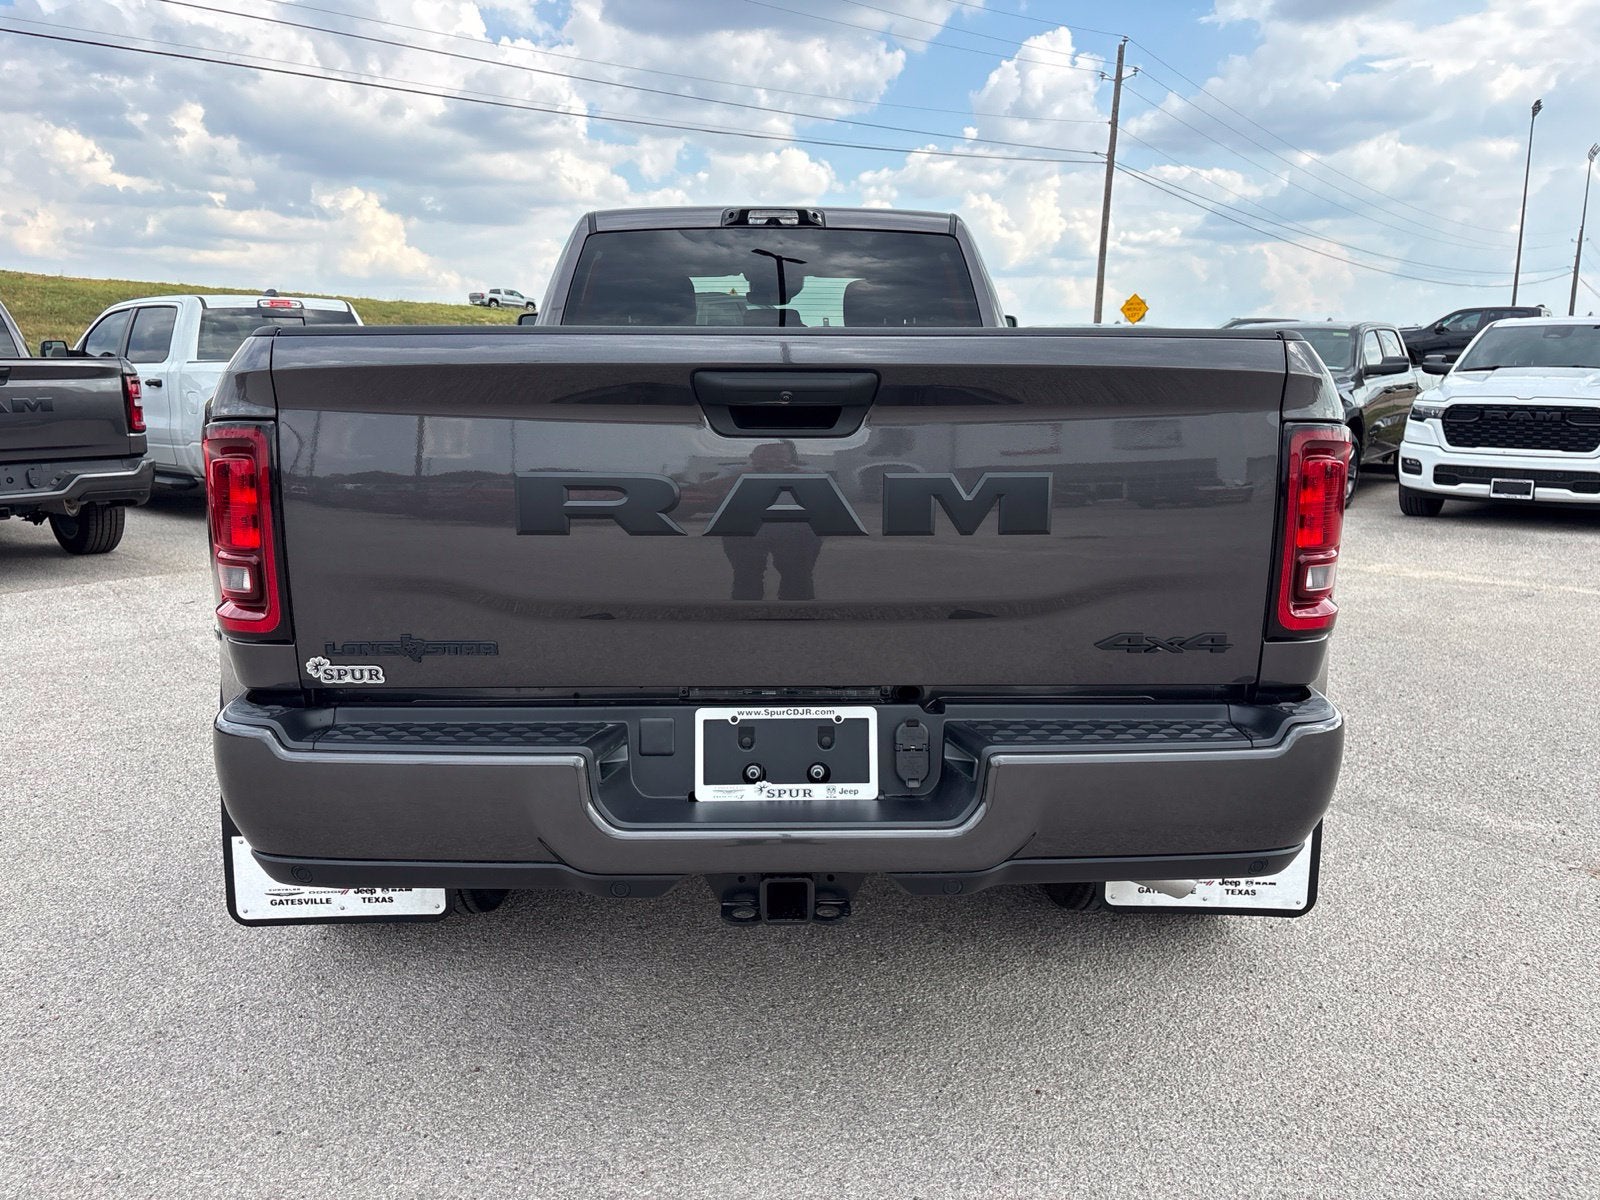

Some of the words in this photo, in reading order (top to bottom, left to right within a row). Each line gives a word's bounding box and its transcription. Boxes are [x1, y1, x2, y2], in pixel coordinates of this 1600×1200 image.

[1483, 410, 1562, 421] RAM
[515, 472, 1053, 536] RAM
[324, 641, 402, 656] LONE
[424, 640, 499, 656] STAR
[322, 667, 384, 682] SPUR
[737, 708, 835, 717] www.SpurCDJR.com
[766, 788, 813, 799] SPUR
[838, 787, 859, 796] Jeep
[1218, 879, 1241, 888] Jeep
[353, 887, 377, 896] Jeep
[1224, 888, 1257, 896] TEXAS
[270, 897, 332, 907] GATESVILLE
[361, 896, 394, 904] TEXAS
